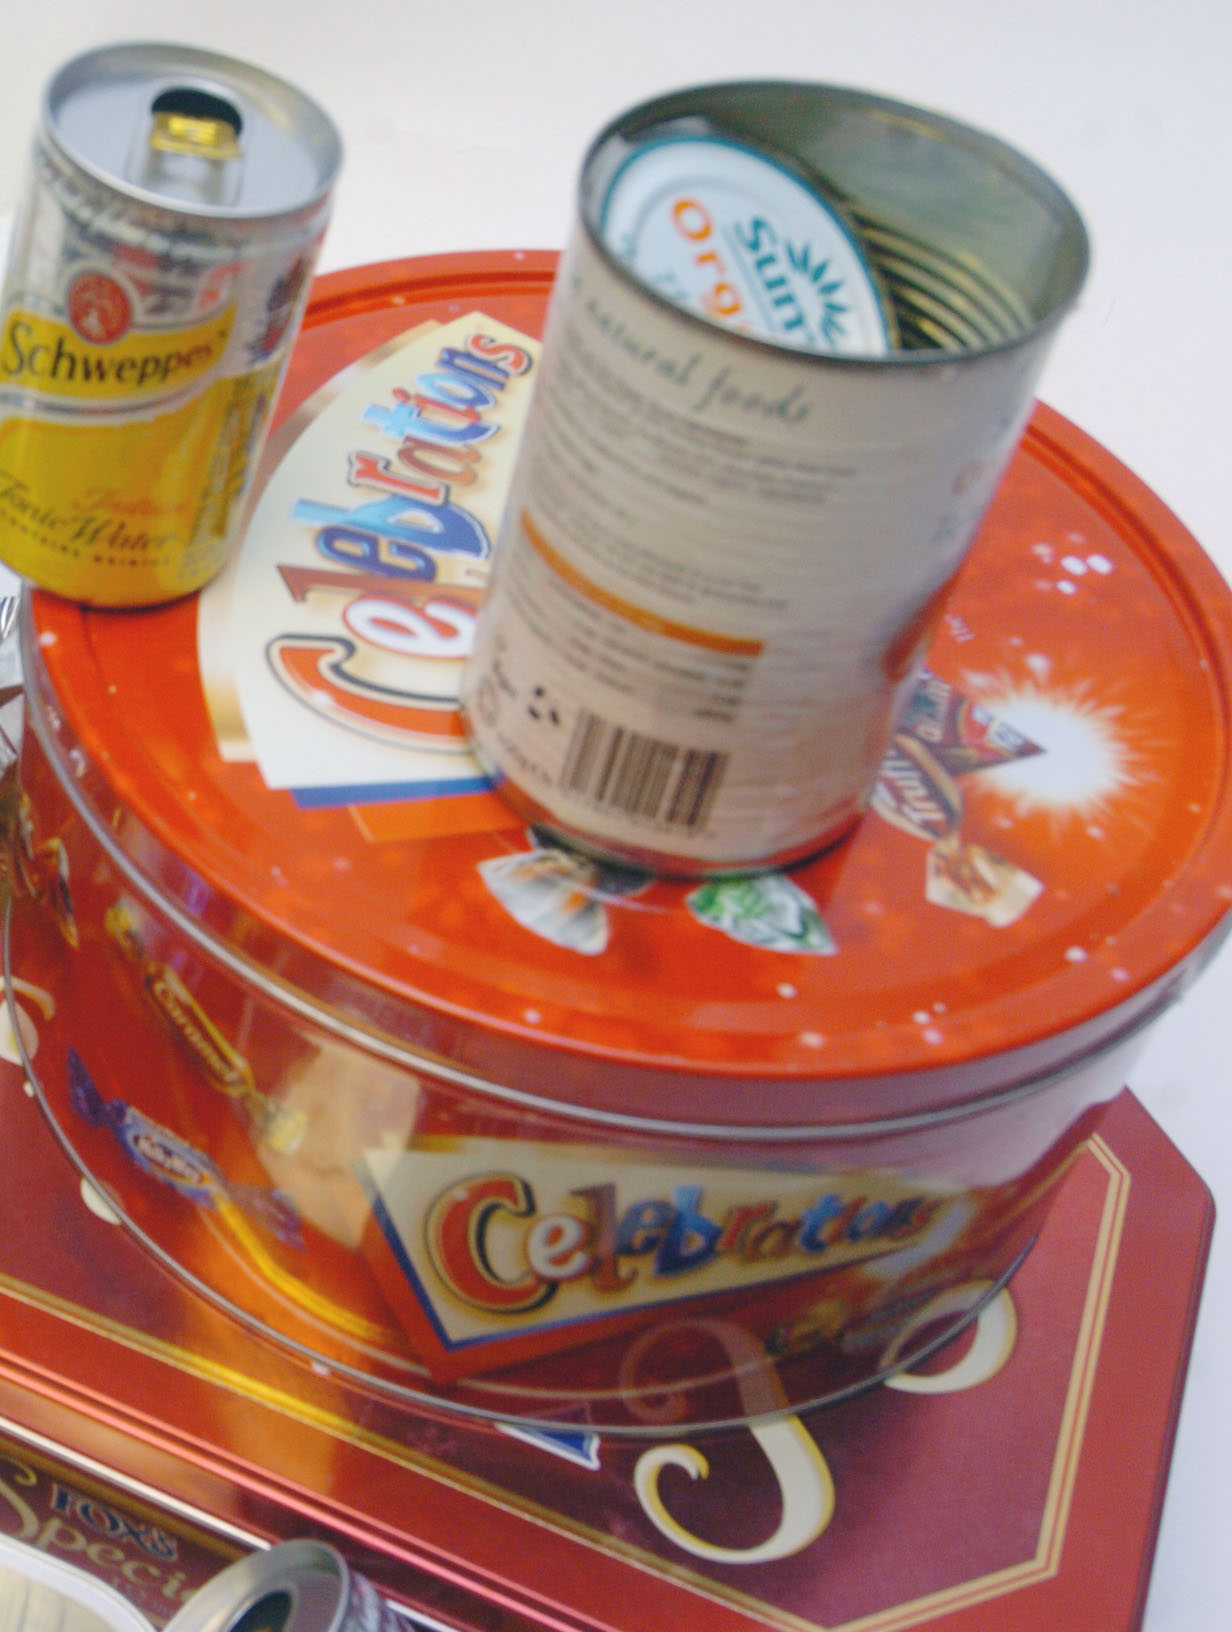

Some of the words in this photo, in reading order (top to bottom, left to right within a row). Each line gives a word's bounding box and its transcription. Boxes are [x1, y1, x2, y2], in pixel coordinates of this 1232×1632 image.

[672, 196, 751, 333] Org
[1, 320, 215, 388] Schweppes
[693, 366, 809, 424] foods
[265, 333, 533, 756] Celebrations
